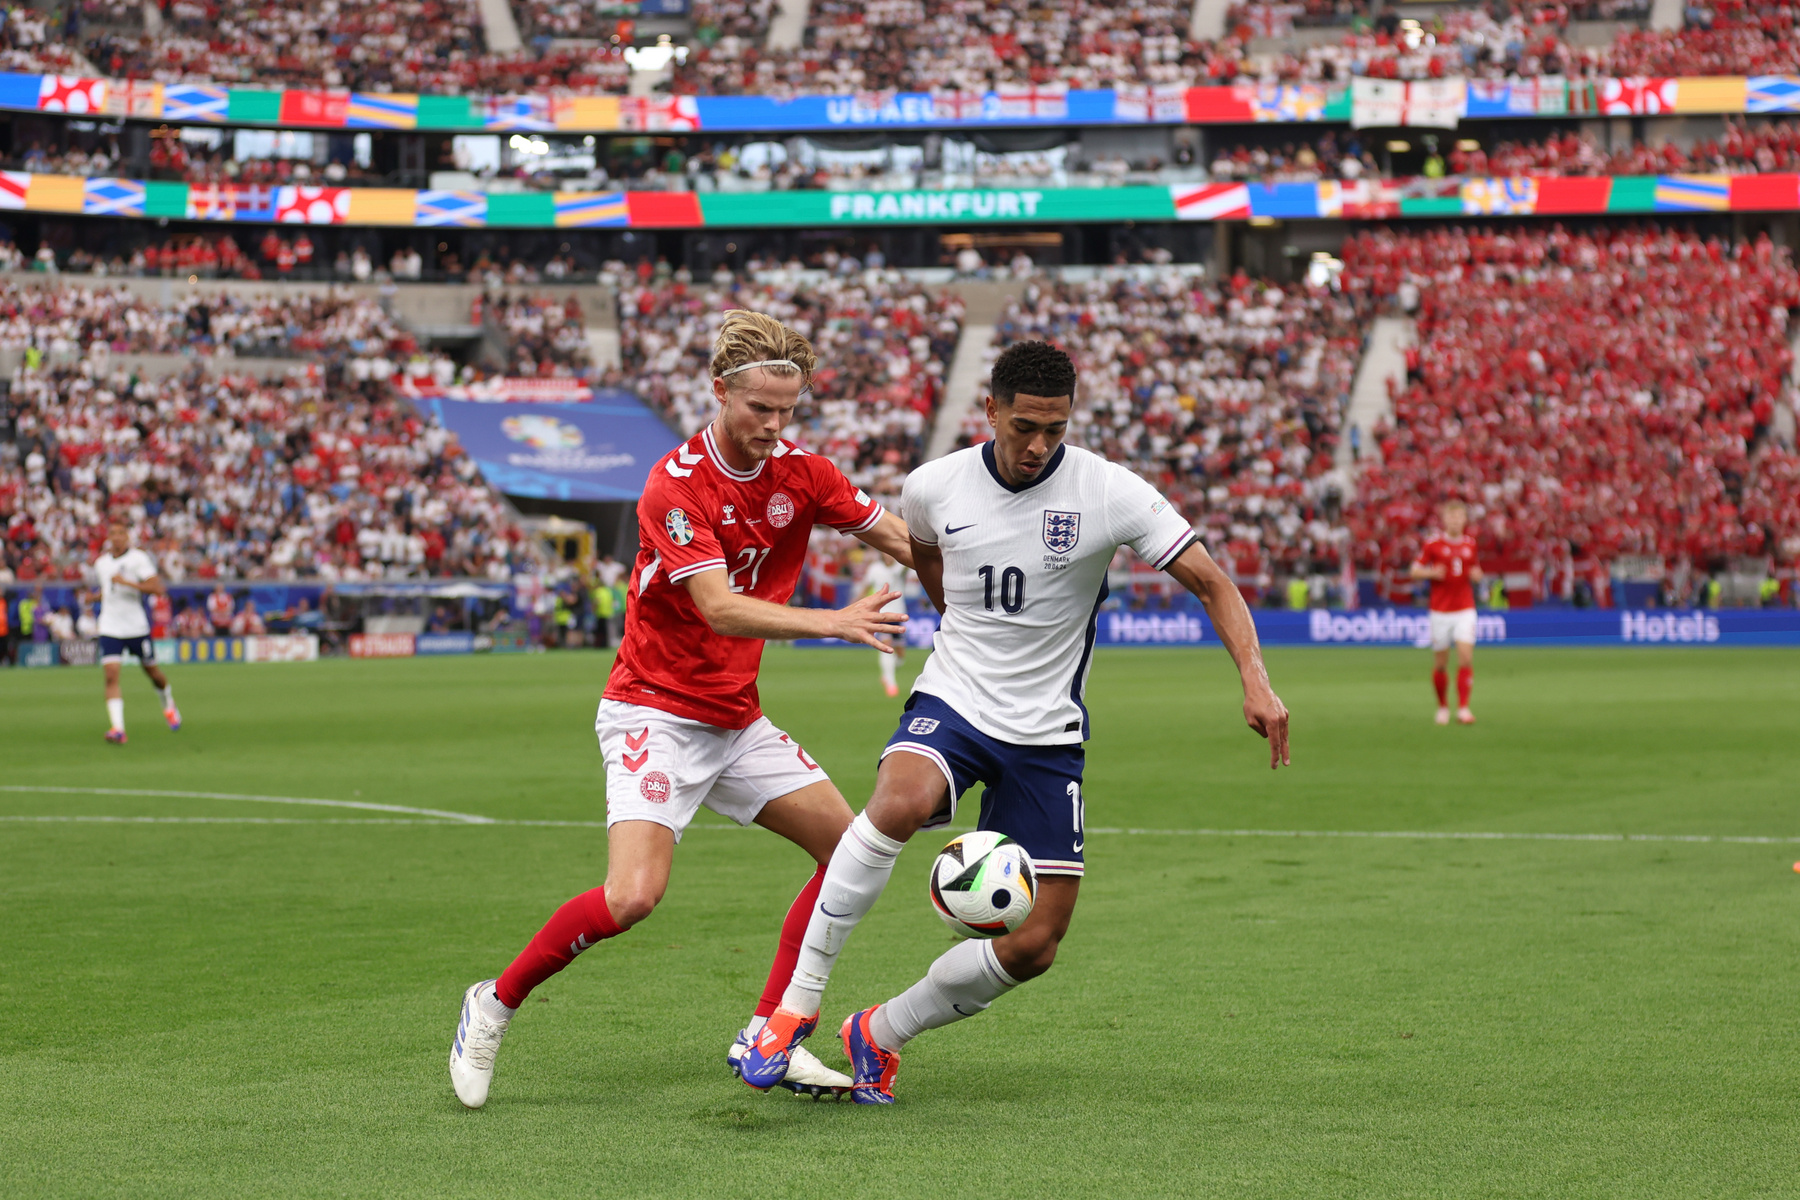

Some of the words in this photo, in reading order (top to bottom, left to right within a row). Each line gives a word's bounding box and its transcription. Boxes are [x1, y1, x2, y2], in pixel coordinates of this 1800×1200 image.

[830, 191, 1043, 220] FRANKFURT
[728, 547, 771, 593] 21
[1043, 555, 1070, 563] DENMARK
[978, 564, 1027, 616] 10
[1108, 612, 1202, 642] Hotels
[1310, 608, 1506, 648] Bookingm
[1620, 609, 1719, 642] Hotels
[647, 781, 666, 792] DBU
[1066, 780, 1085, 833] 1
